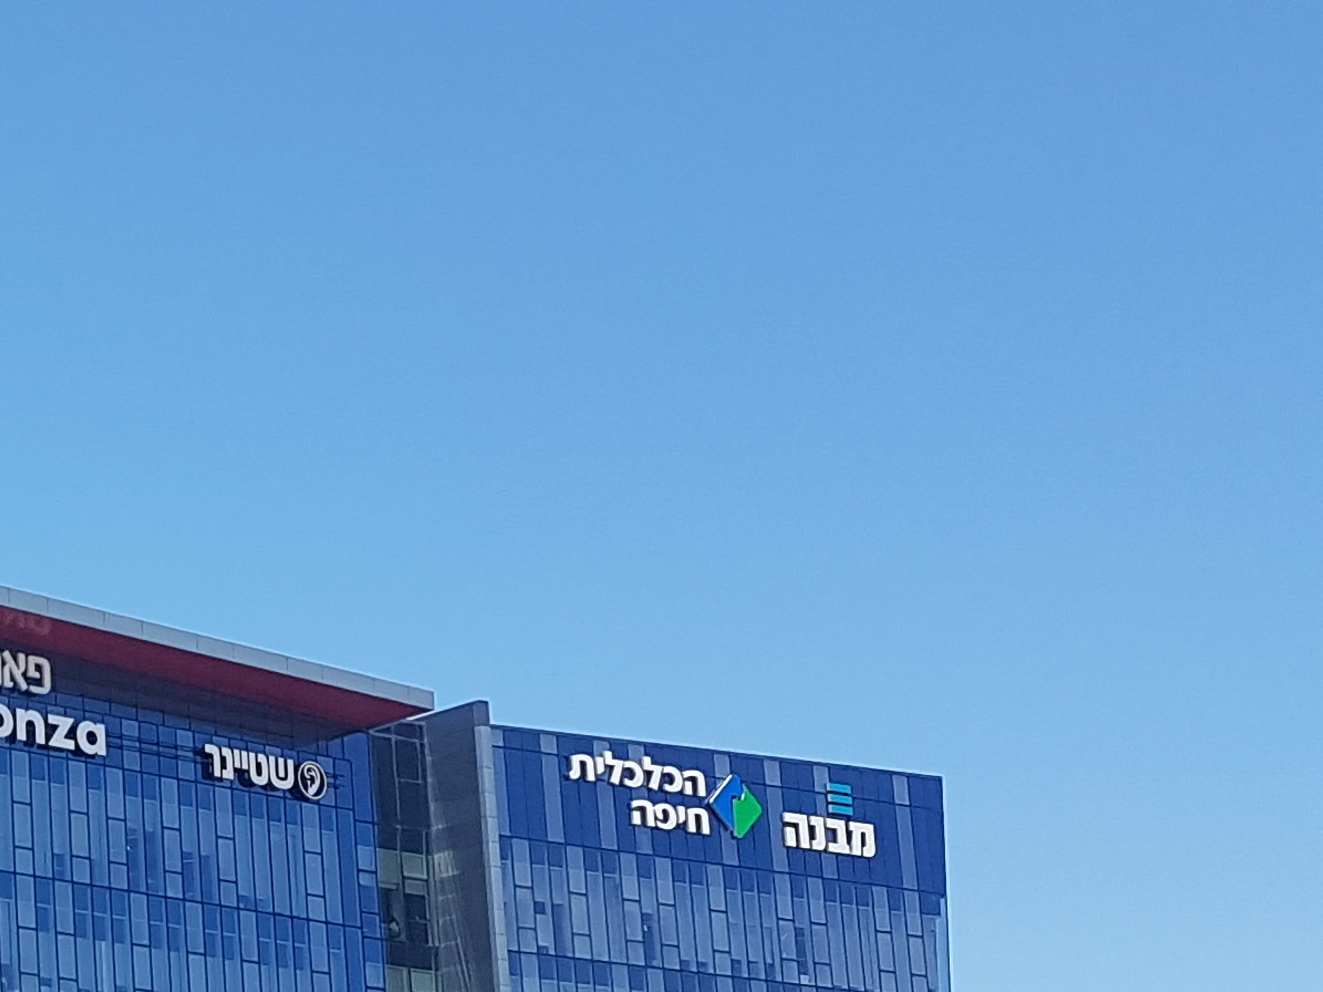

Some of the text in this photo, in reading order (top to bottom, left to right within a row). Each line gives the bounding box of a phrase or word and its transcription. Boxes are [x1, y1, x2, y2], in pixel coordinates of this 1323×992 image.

[204, 743, 295, 790] שטיינר
[568, 751, 707, 797] הכלכלית
[631, 799, 711, 836] חיפה
[782, 812, 876, 858] מבנה
